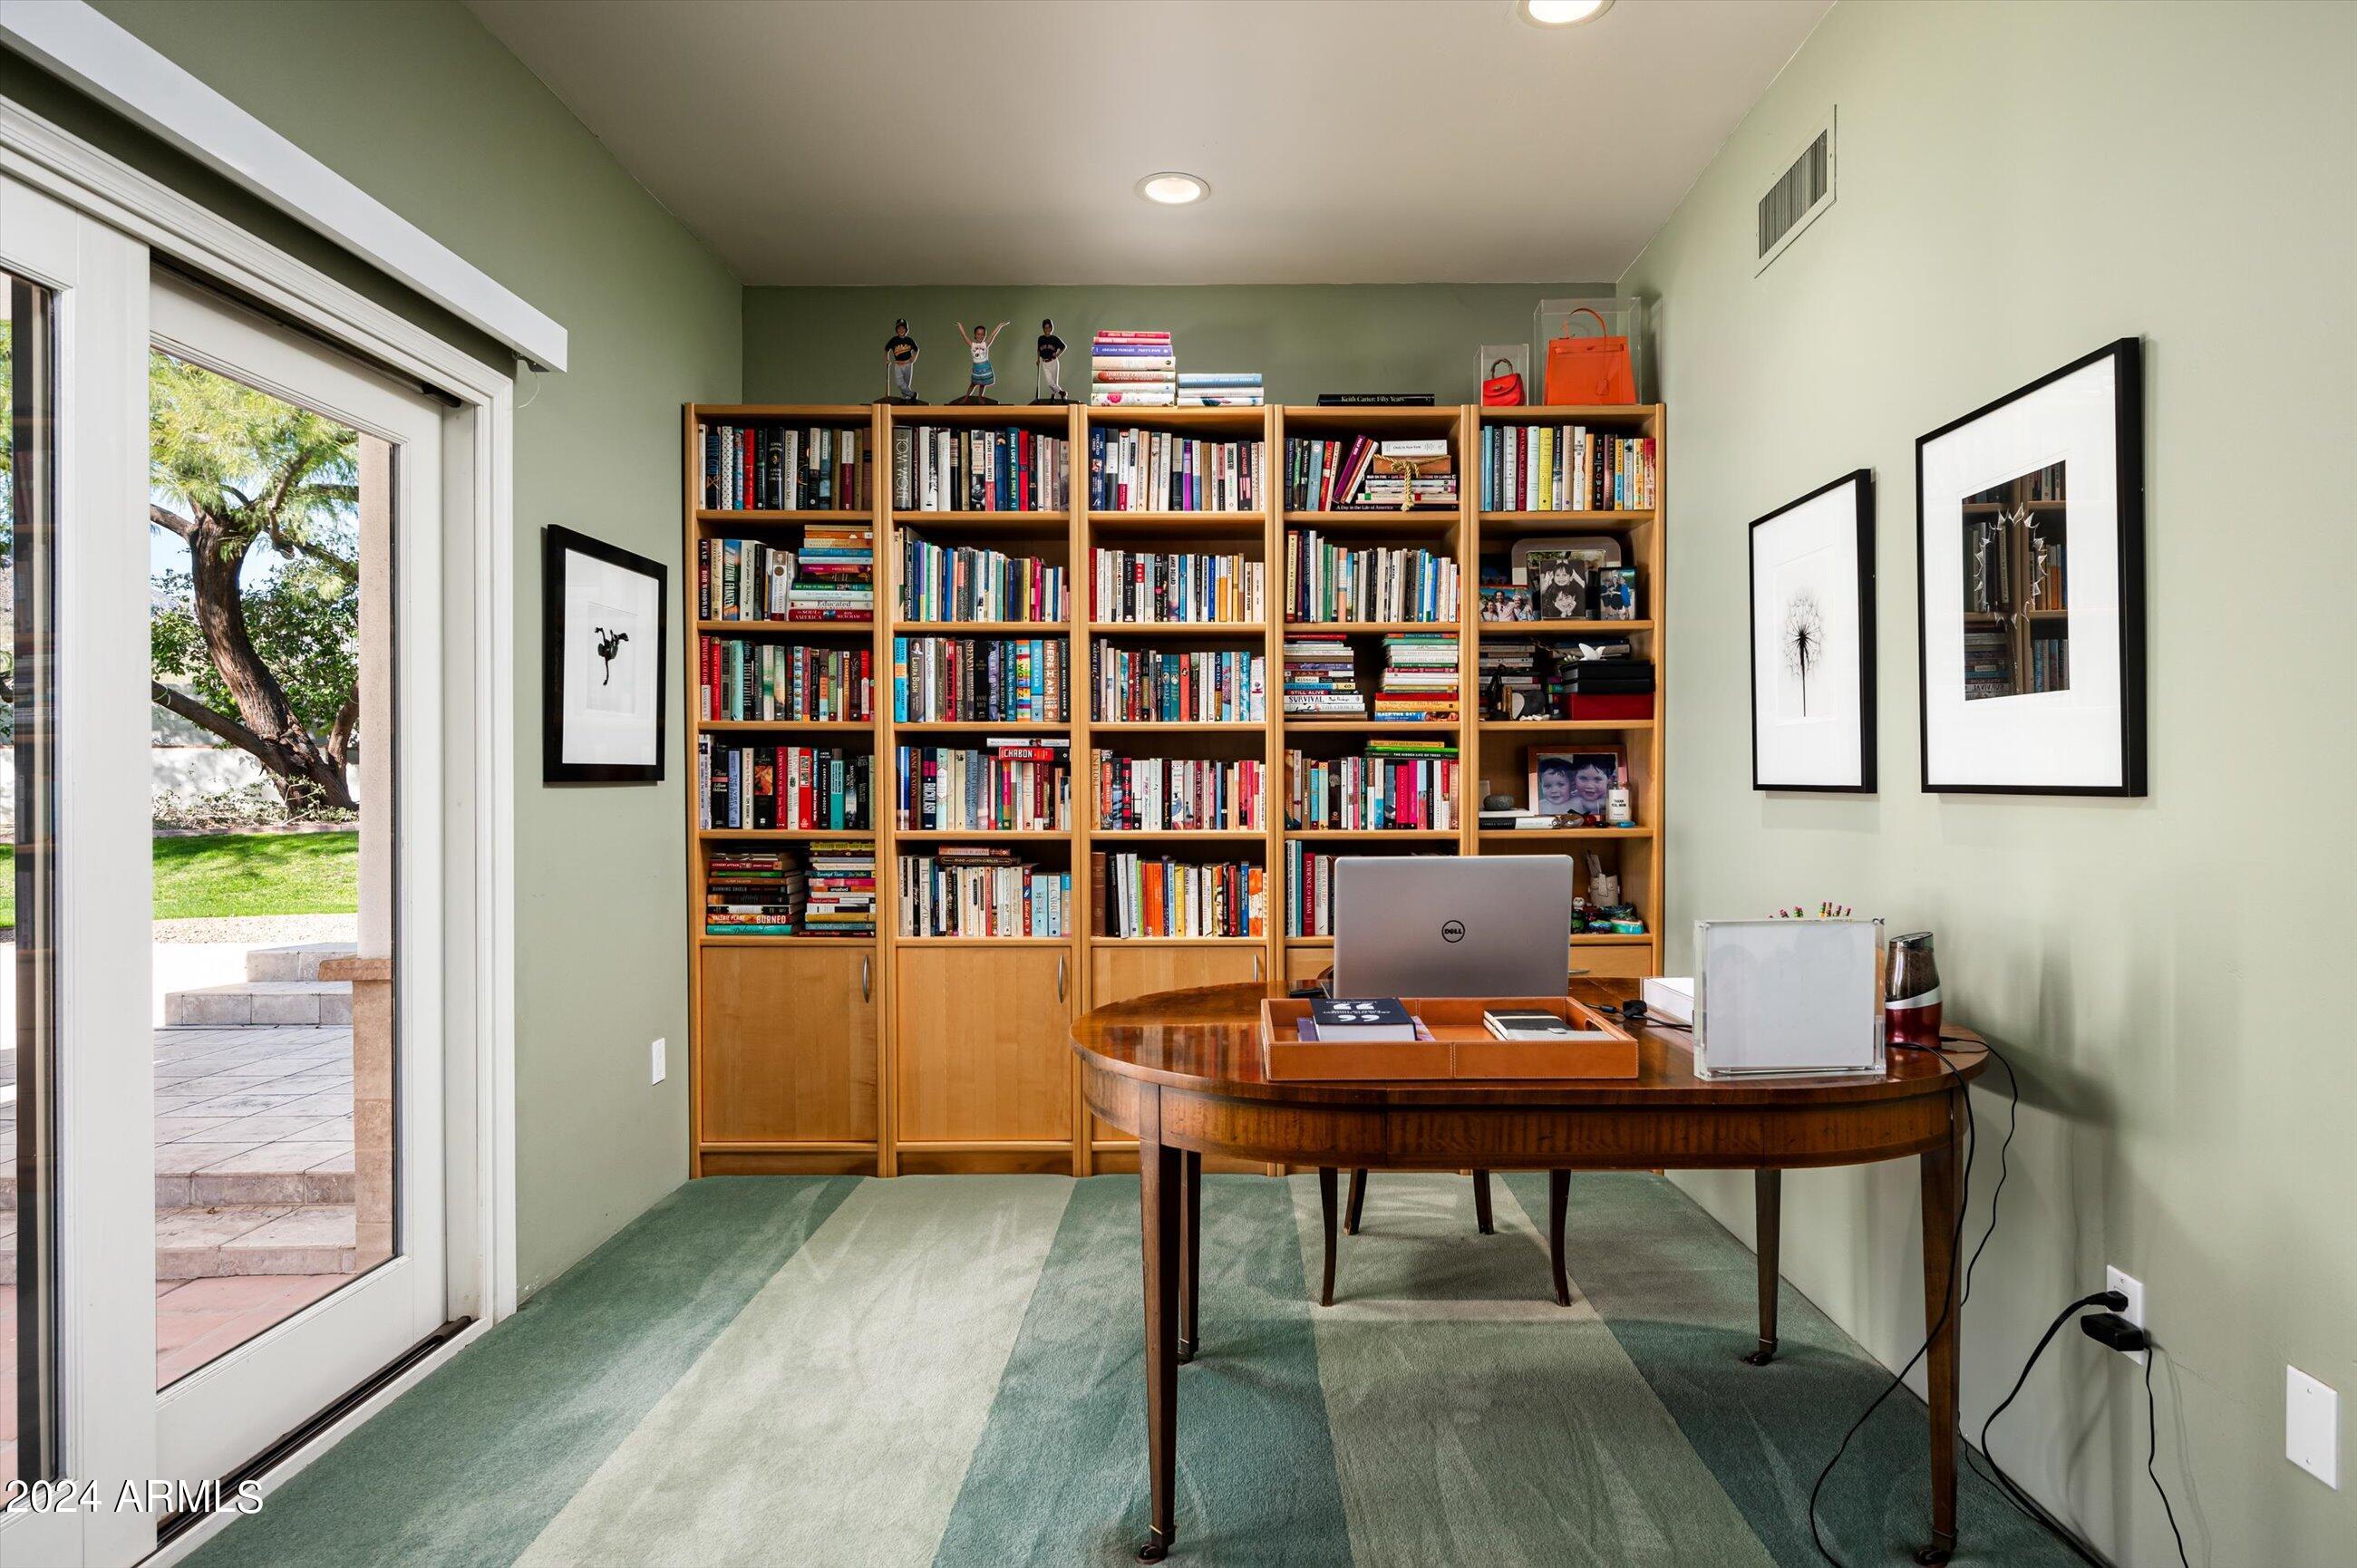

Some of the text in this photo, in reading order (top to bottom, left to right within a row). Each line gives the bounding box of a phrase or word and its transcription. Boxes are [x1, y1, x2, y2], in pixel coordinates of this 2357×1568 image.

[897, 438, 909, 501] TOM WOLFE
[724, 583, 735, 608] FRANZEN
[911, 657, 920, 692] LAURA BUSH
[1047, 670, 1054, 678] I
[1047, 679, 1054, 694] AM
[1004, 750, 1033, 758] CHABON
[923, 783, 936, 814] BACKLASH
[756, 915, 786, 924] BURNED
